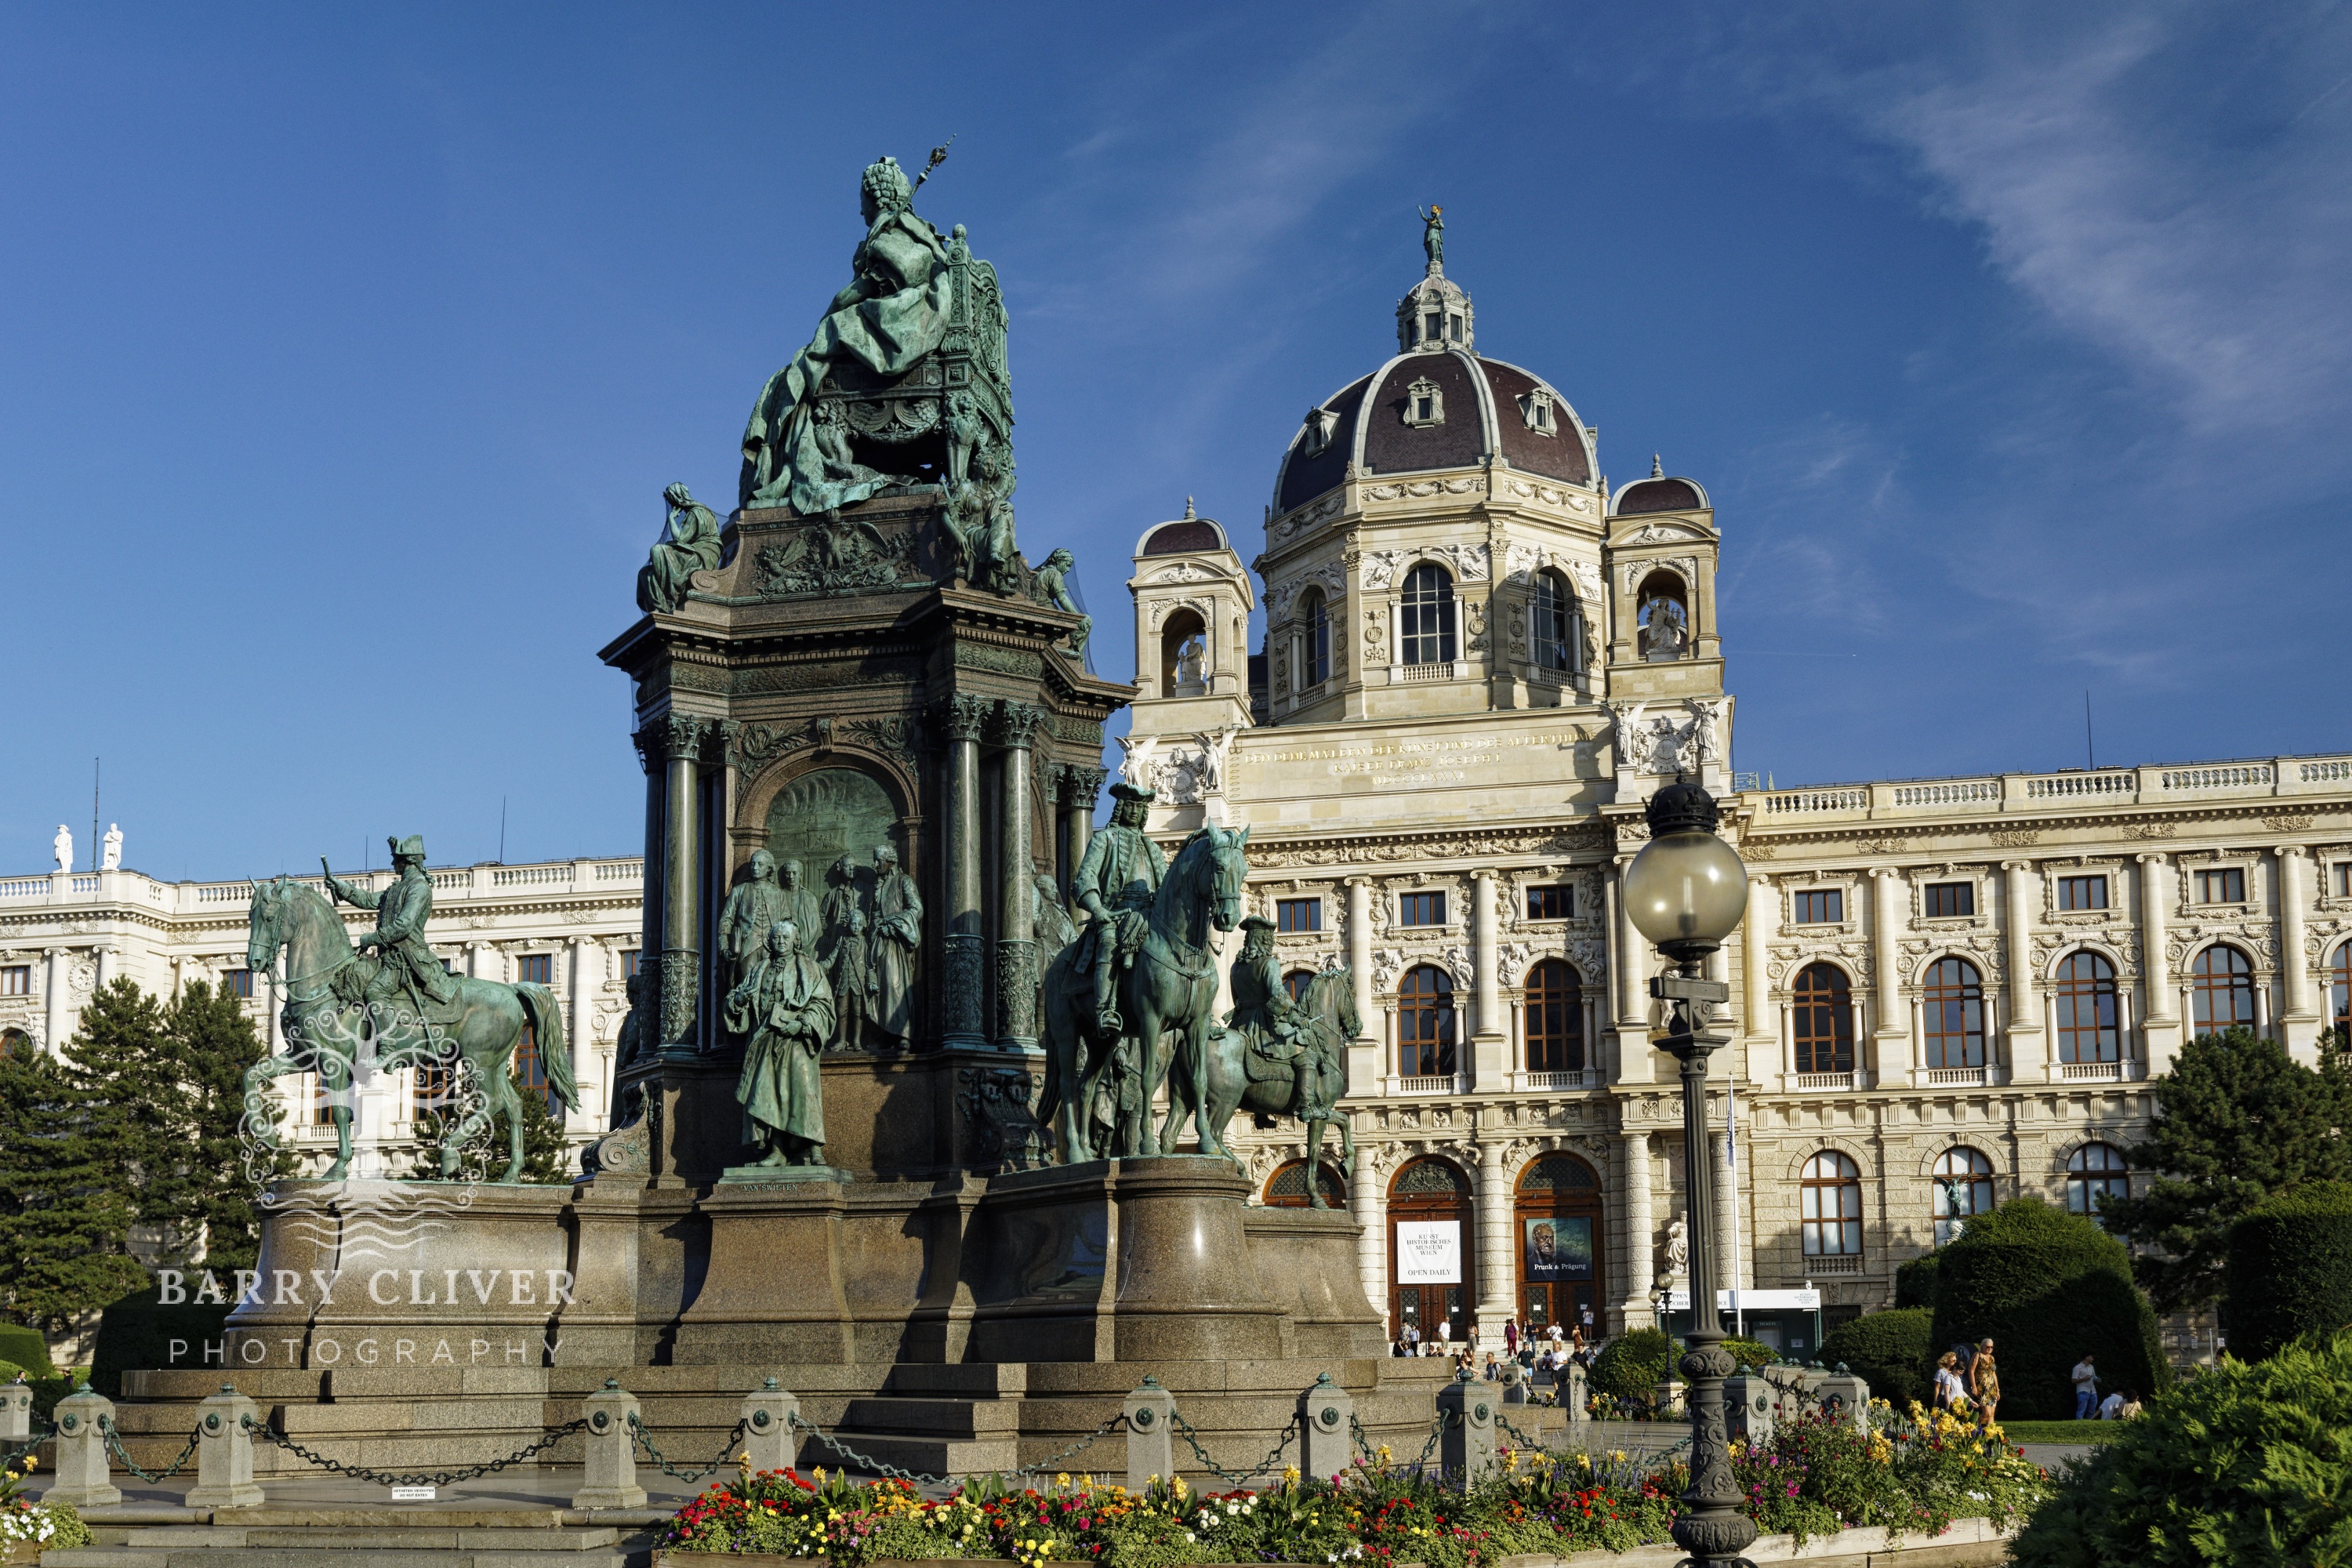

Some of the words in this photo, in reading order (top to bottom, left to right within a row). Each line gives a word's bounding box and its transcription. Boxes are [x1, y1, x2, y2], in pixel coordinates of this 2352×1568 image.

[1245, 753, 1270, 764] DEN
[1370, 746, 1396, 756] DER
[1399, 742, 1442, 754] KUNST
[1446, 739, 1473, 750] UND
[1478, 738, 1502, 749] DES
[1507, 731, 1596, 746] ALTERTHUMS
[1334, 761, 1384, 773] KAISER
[1390, 757, 1431, 769] FRANZ
[1438, 753, 1491, 766] JOSEPH
[1496, 753, 1504, 762] I.
